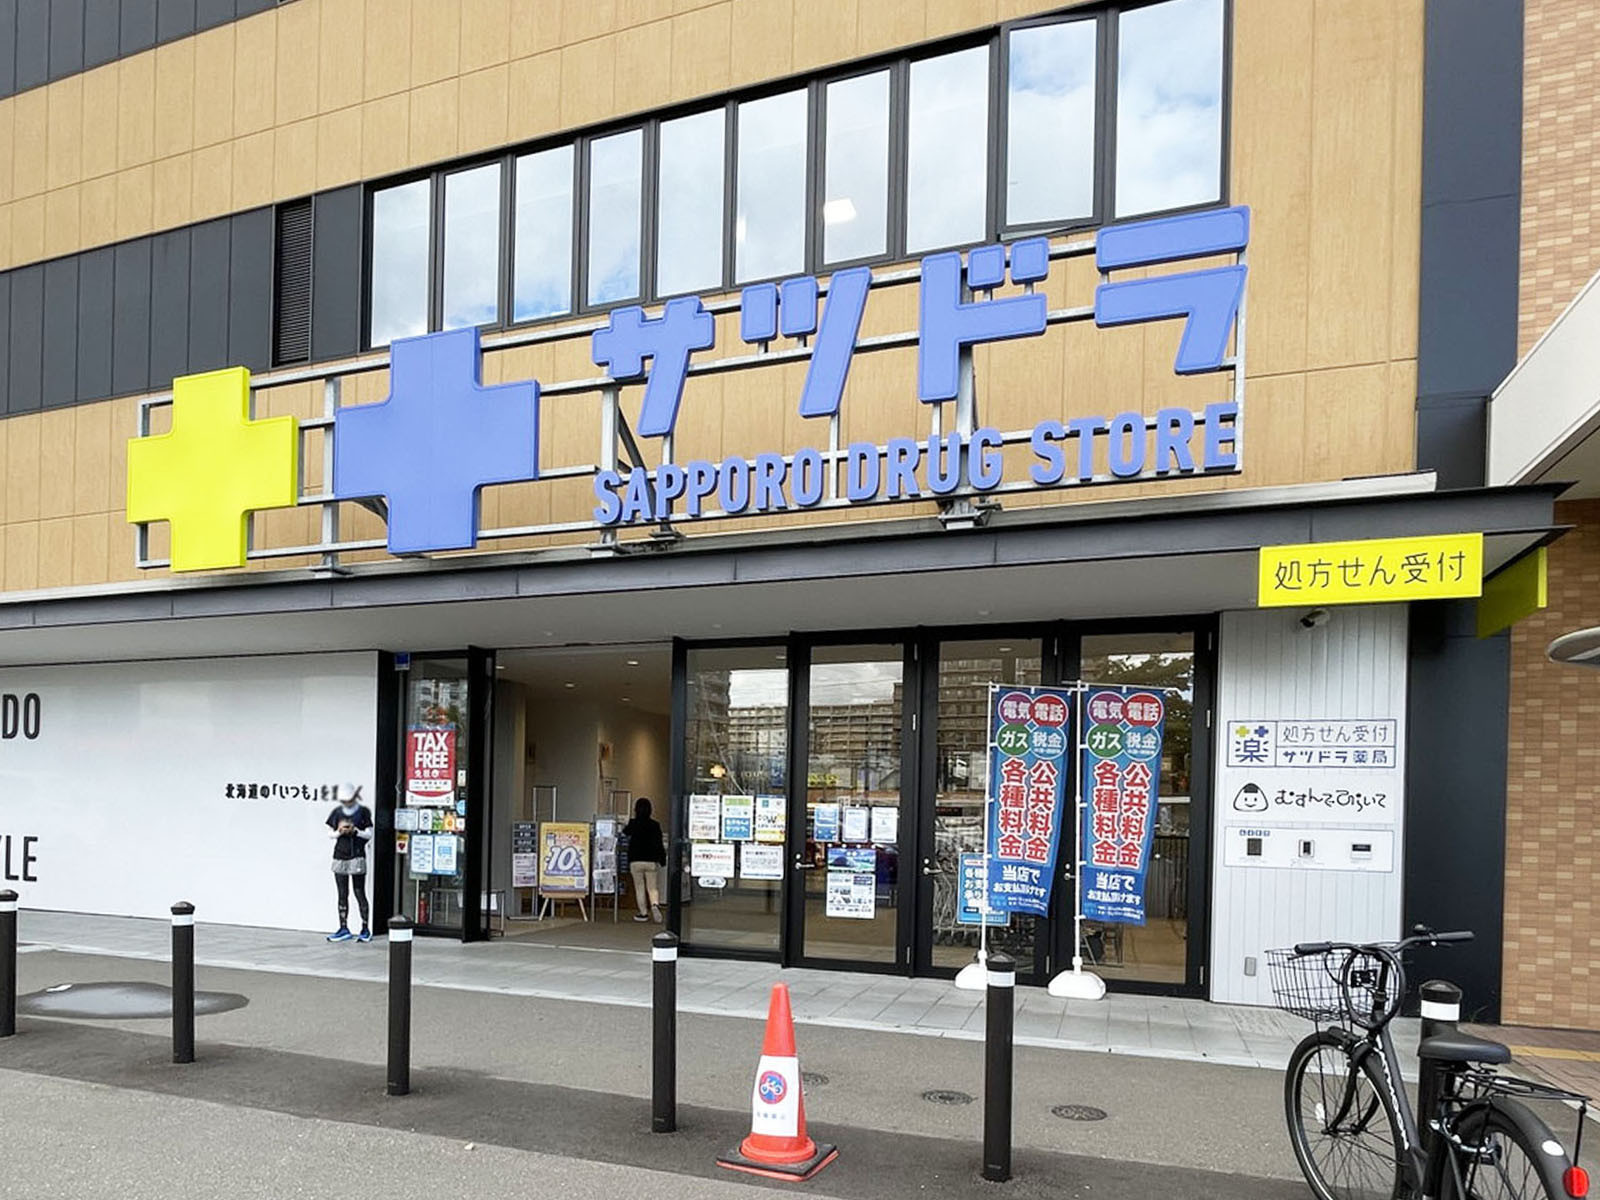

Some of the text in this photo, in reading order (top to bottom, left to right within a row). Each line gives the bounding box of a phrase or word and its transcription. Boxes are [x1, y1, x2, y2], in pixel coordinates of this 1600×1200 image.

[592, 204, 1250, 438] サツドラ
[593, 402, 1238, 526] SAPPORO DRUG STORE
[1274, 550, 1466, 590] 処方せん受付
[1, 692, 41, 740] DO
[1003, 701, 1031, 720] 電気
[1034, 702, 1065, 722] 電話
[1092, 701, 1123, 720] 電気
[1127, 702, 1160, 722] 電話
[413, 732, 449, 751] TAX
[1001, 732, 1028, 749] ガス
[1032, 732, 1062, 748] 税金
[1092, 733, 1121, 750] ガス
[1126, 732, 1157, 750] 税金
[1283, 725, 1388, 743] 処方せん受付
[414, 751, 449, 769] FREE
[1283, 750, 1388, 764] サツドラ薬局
[1000, 759, 1027, 859] 各種料金
[1025, 760, 1058, 862] 公共料金
[1093, 760, 1122, 866] 各種料金
[1119, 762, 1152, 869] 公共料金
[0, 835, 38, 882] LE
[1002, 864, 1041, 884] 当店で
[1096, 871, 1135, 891] 当店で
